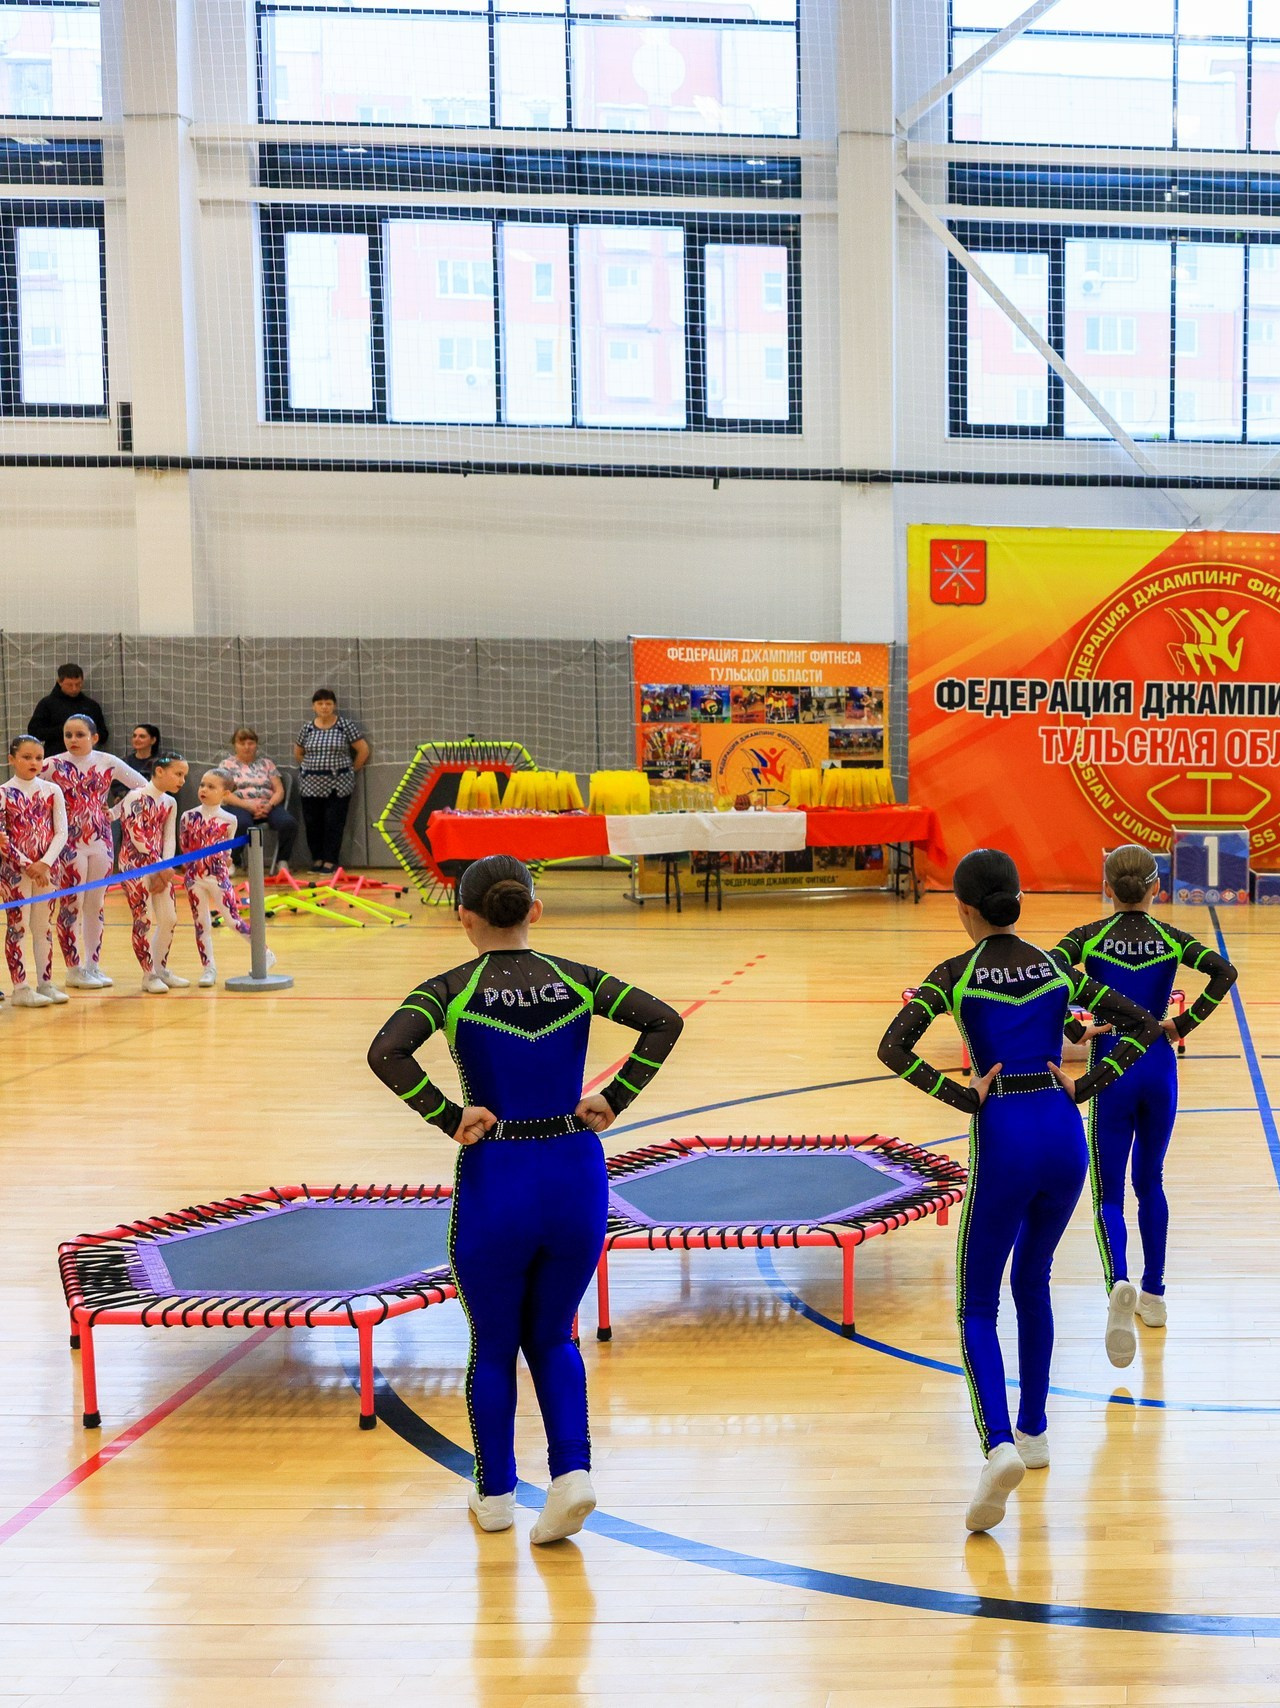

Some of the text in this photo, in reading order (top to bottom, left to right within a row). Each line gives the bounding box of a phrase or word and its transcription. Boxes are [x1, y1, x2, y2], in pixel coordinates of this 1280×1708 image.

[1074, 602, 1131, 682] ДЕРАЦИЯ
[1132, 570, 1243, 609] ДЖАМПИНГ
[667, 647, 861, 665] ФЕДЕРАЦИЯ ДЖАМПИНГ ФИТНЕСА
[709, 666, 823, 683] ТУЛЬСКОЙ ОБЛАСТИ
[935, 677, 1133, 719] ФЕДЕРАЦИЯ
[1039, 726, 1217, 766] ТУЛЬСКАЯ
[1203, 836, 1218, 887] 1
[1103, 938, 1165, 955] POLICE
[975, 962, 1053, 984] POLICE
[483, 982, 569, 1007] POLICE
